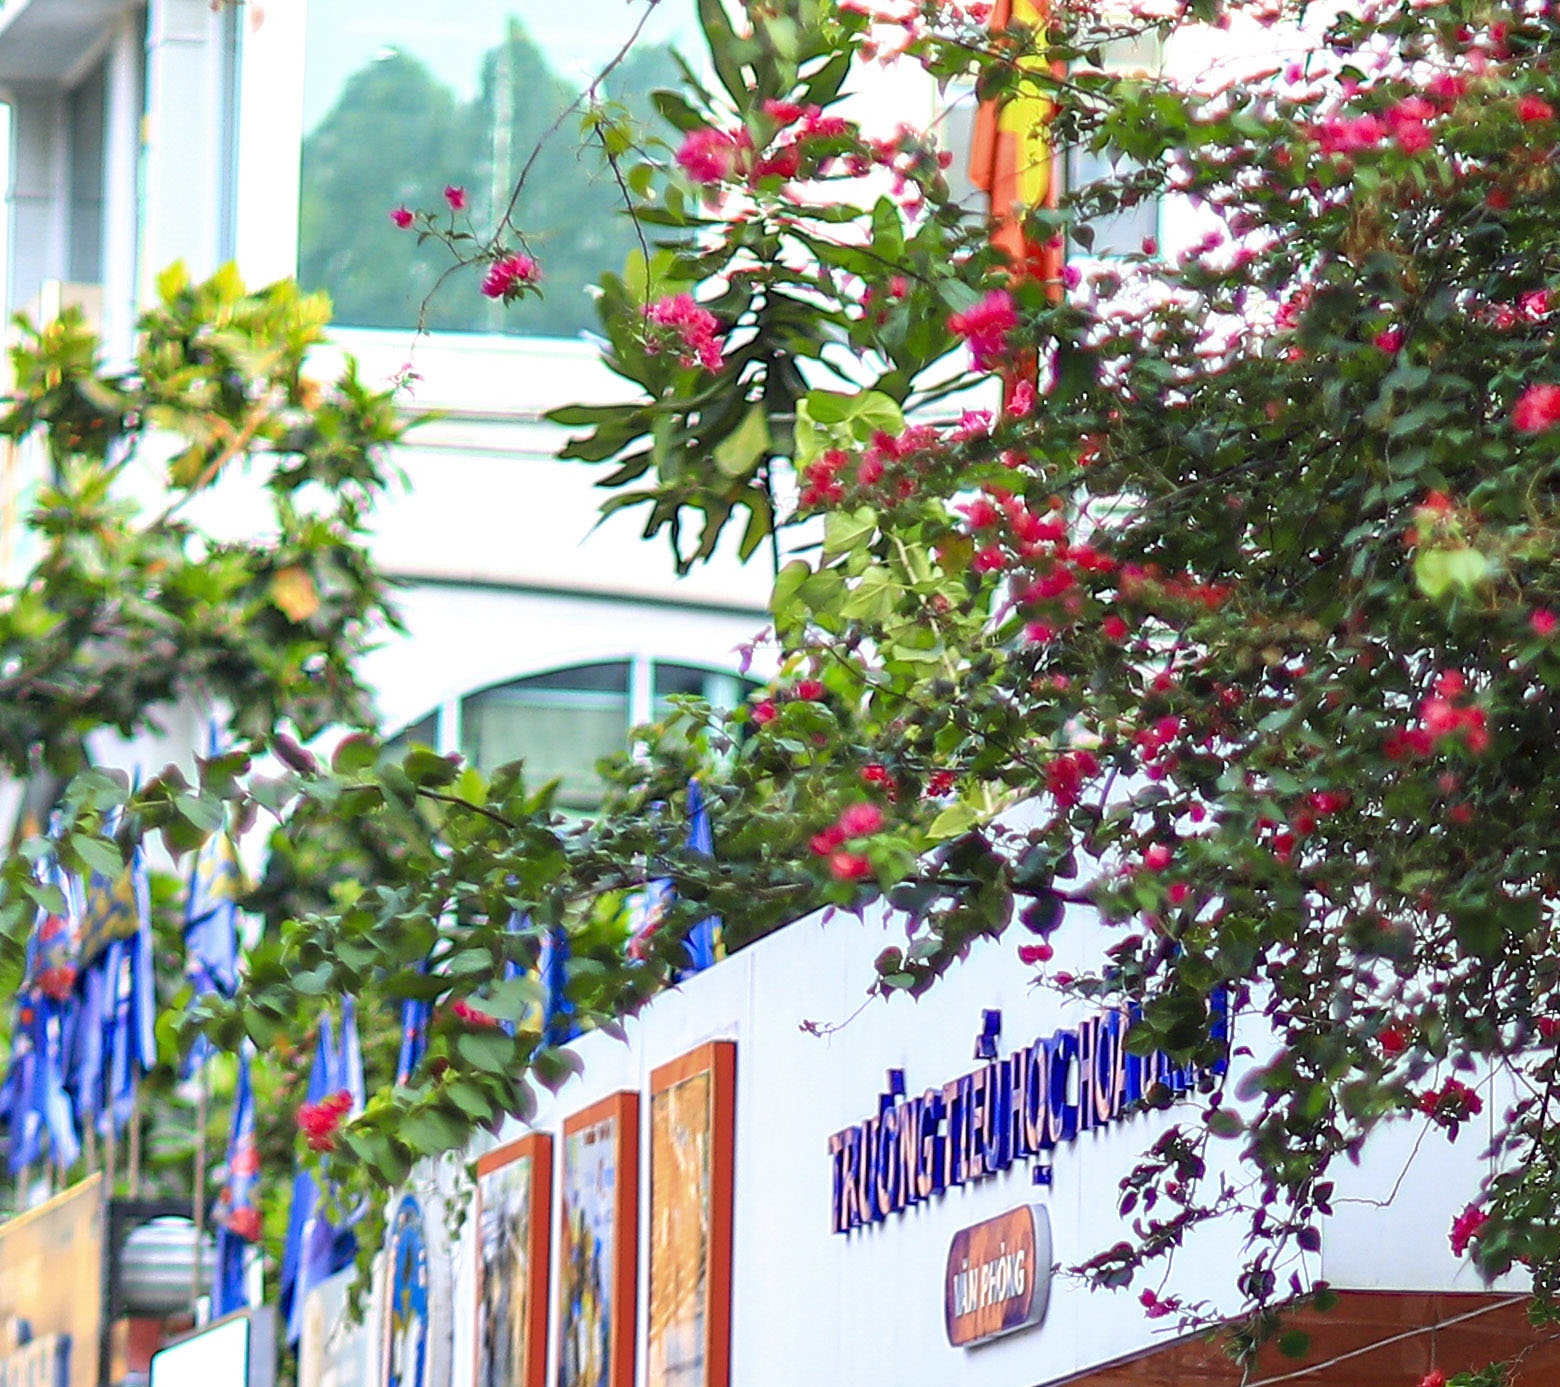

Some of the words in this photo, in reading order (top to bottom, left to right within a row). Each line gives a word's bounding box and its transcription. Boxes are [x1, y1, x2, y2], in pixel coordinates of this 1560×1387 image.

[828, 1068, 944, 1234] TRƯỜNG
[1009, 1028, 1081, 1186] HỌC
[952, 1257, 979, 1318] VĂN
